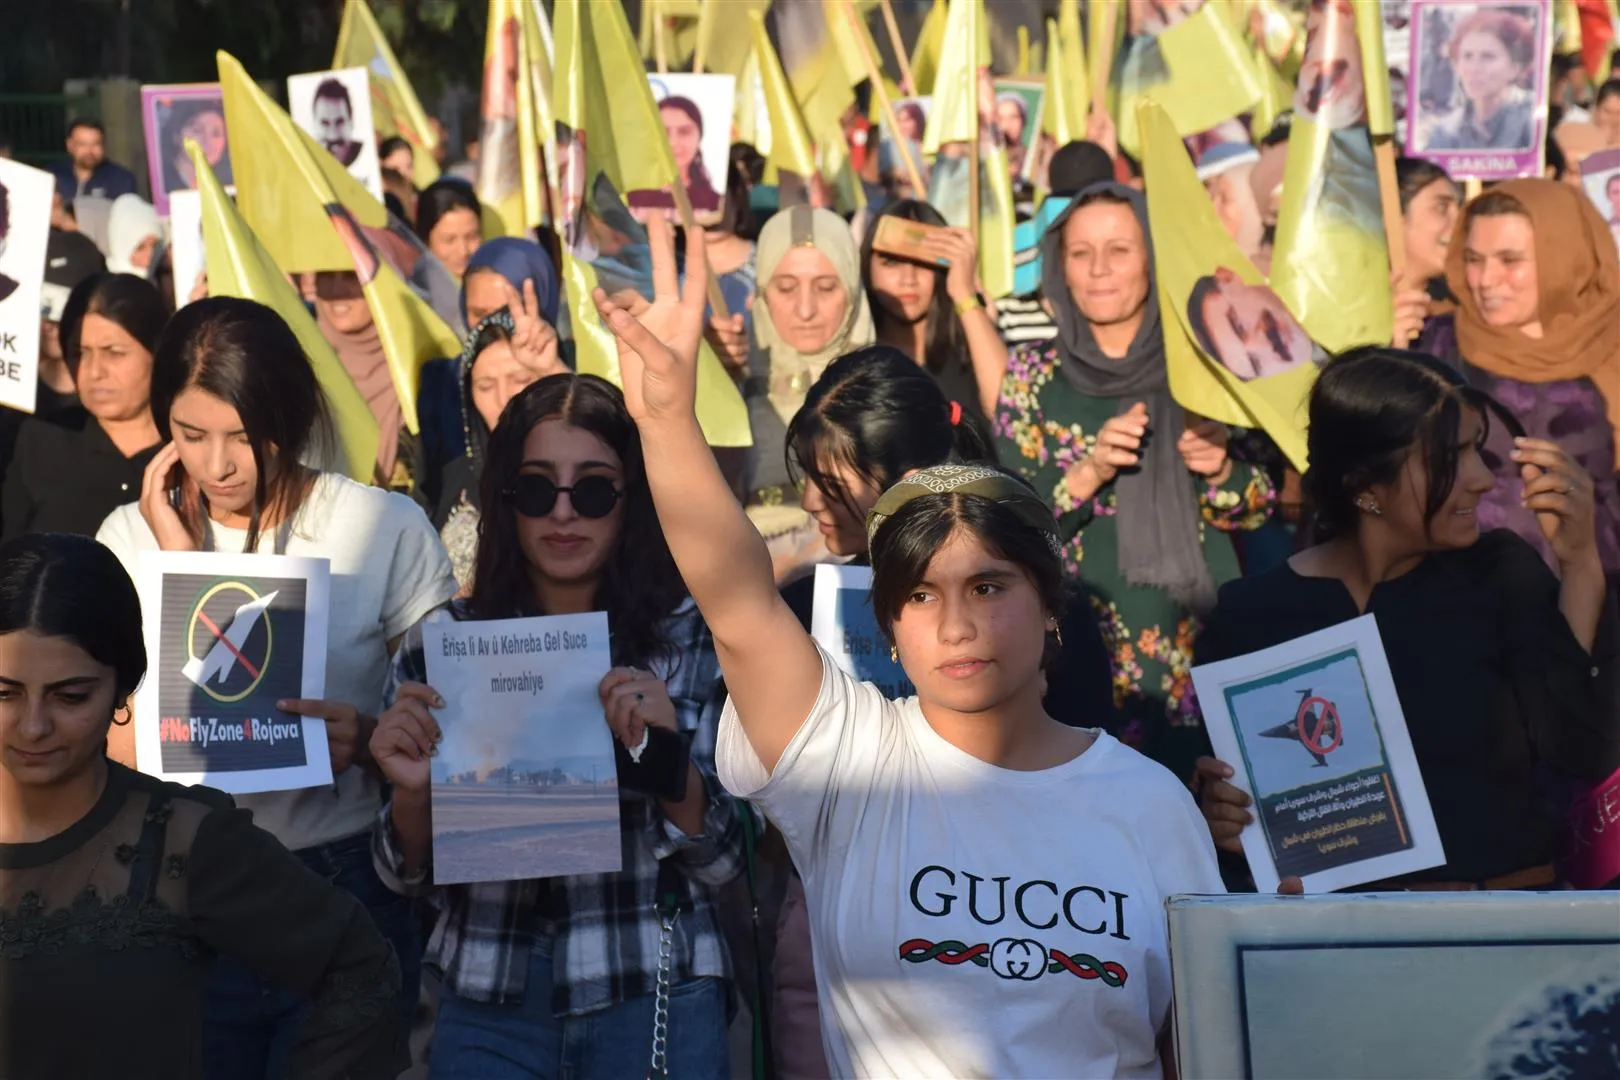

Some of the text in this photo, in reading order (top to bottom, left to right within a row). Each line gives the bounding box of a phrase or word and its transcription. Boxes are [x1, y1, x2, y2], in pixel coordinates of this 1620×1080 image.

[478, 636, 490, 656] Av
[501, 633, 542, 655] Kehreba
[544, 630, 560, 651] Gel
[562, 630, 588, 650] Suce
[491, 671, 544, 696] mirovahiye
[160, 716, 299, 747] #NoFlyZone4Rojava
[909, 865, 1131, 940] GUCCI
